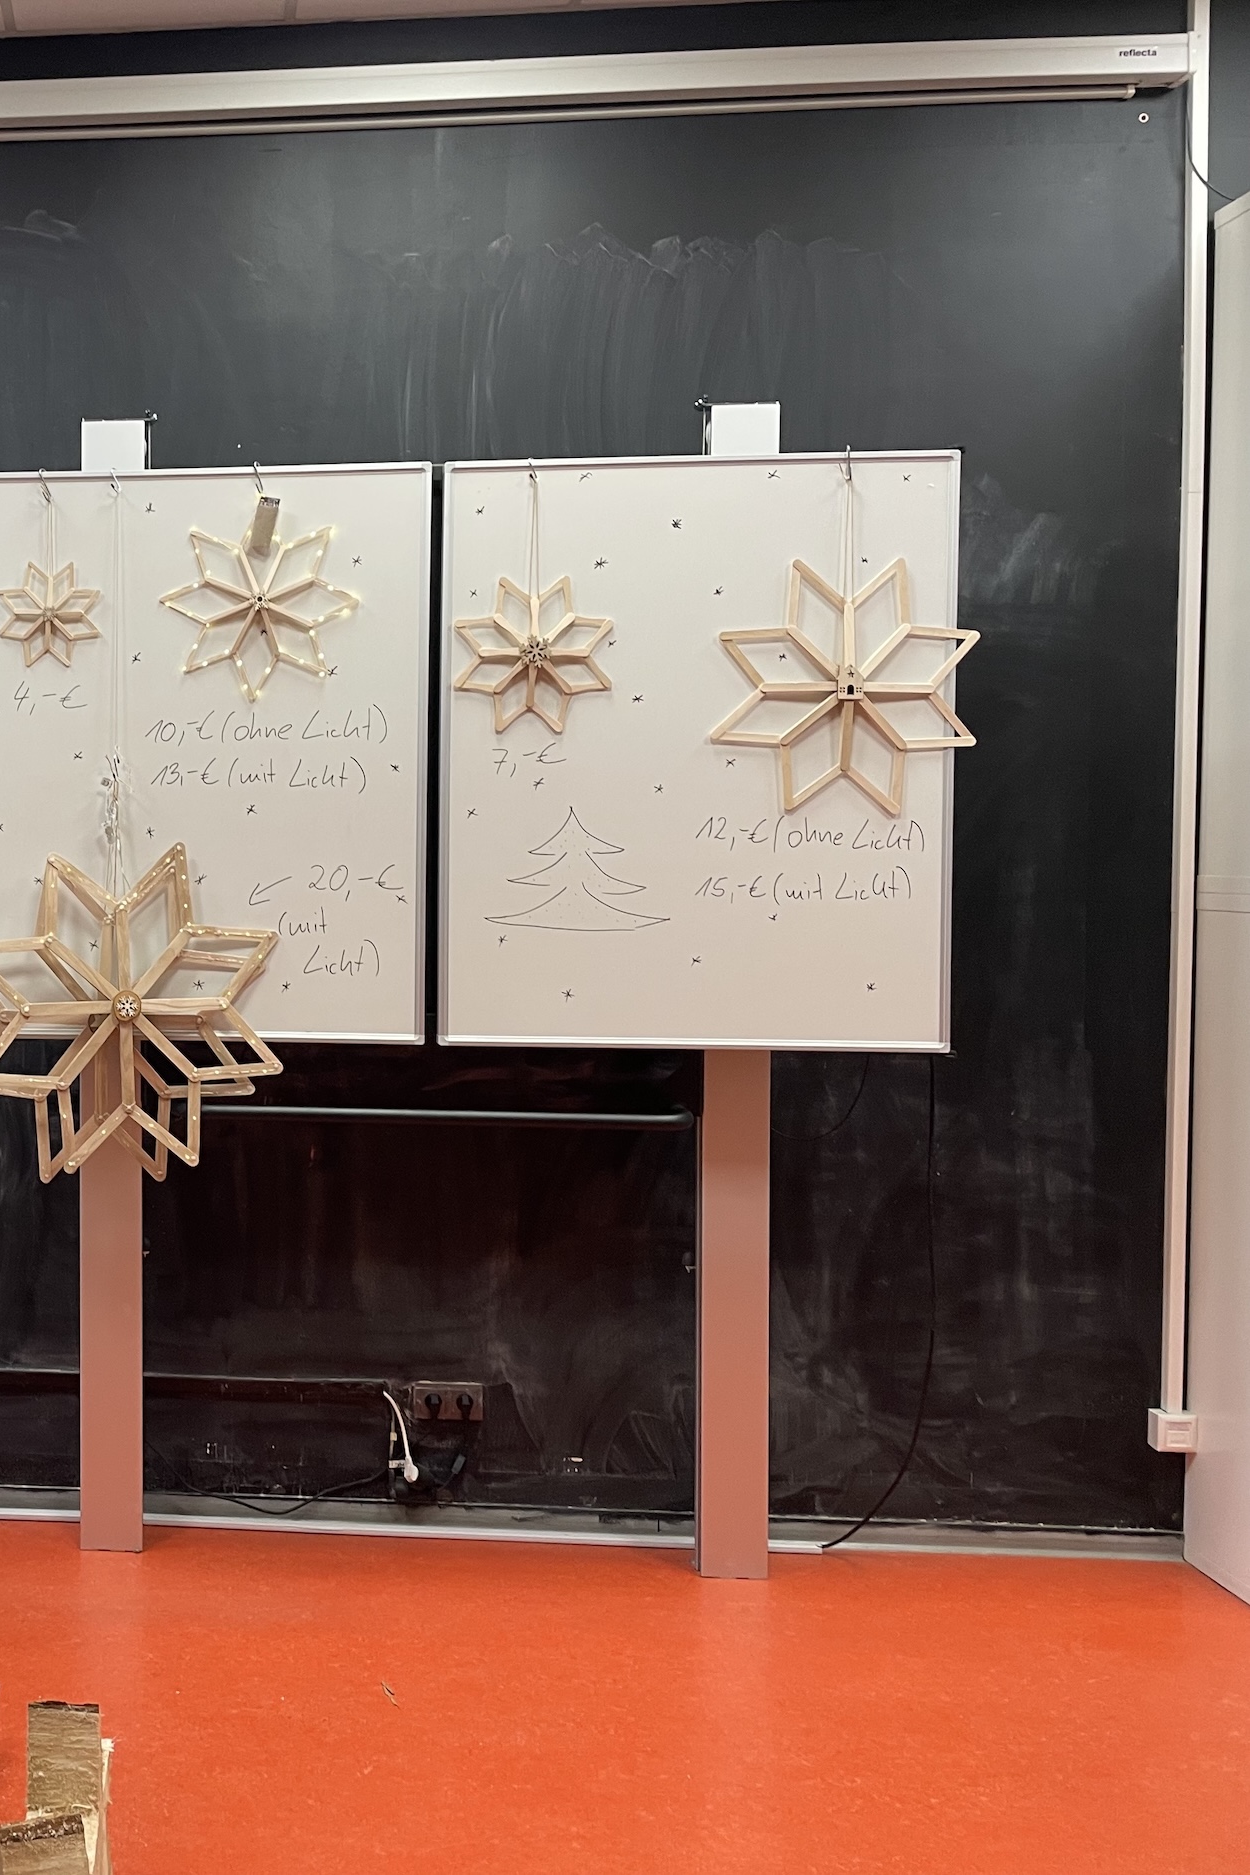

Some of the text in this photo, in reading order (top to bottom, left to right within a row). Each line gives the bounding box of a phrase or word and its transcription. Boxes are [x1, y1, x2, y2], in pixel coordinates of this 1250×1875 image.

[1119, 49, 1157, 57] reflecta
[301, 703, 388, 744] Licht)
[288, 756, 367, 794] Licht)
[303, 939, 380, 977] Licht)
